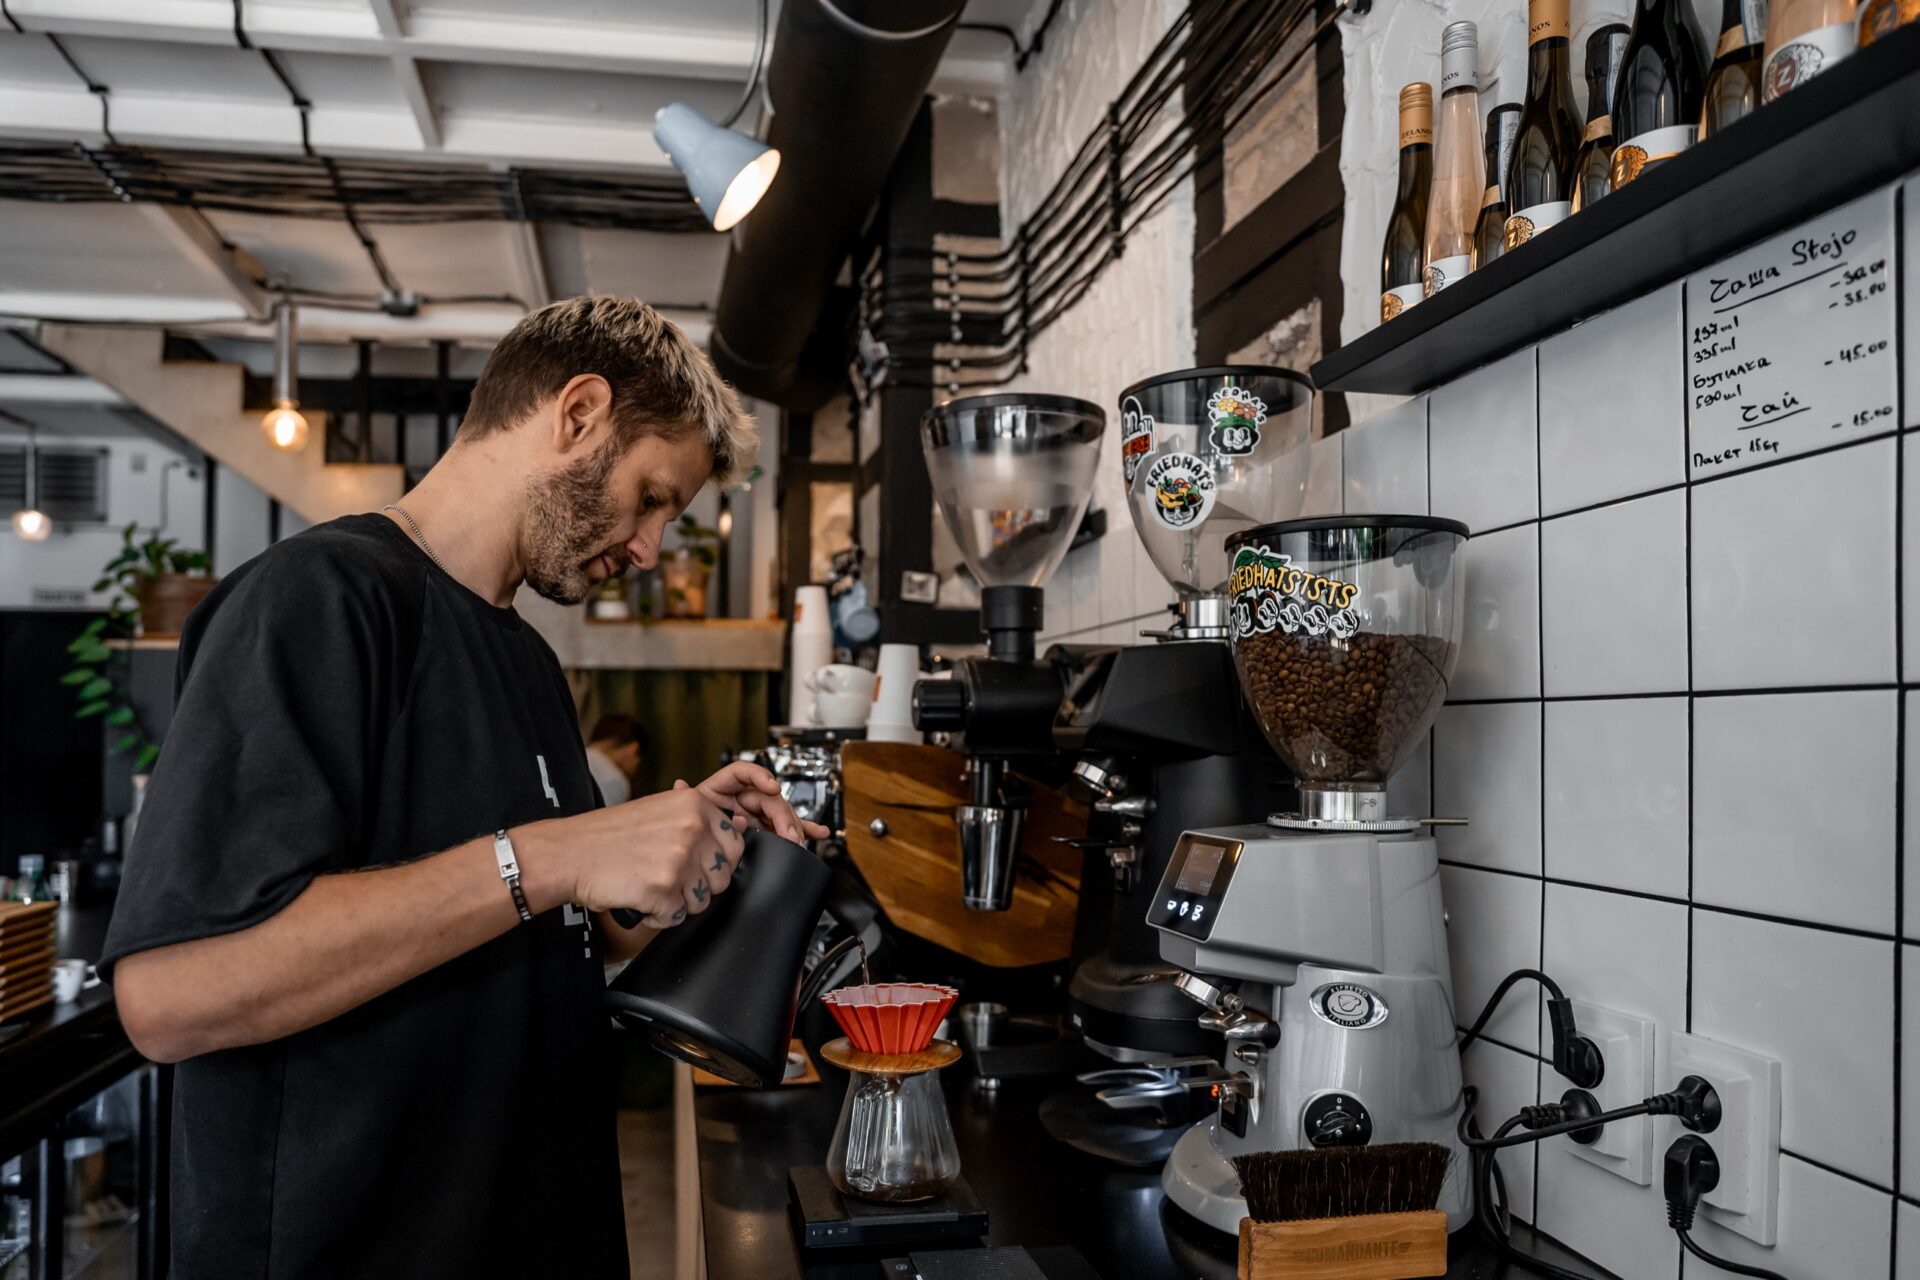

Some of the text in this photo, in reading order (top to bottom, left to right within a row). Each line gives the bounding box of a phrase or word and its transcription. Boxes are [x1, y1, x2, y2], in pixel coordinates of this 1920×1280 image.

[1791, 229, 1857, 266] Stojo
[1209, 388, 1266, 423] FRIEDHATS
[1147, 455, 1214, 490] FRIEDHATS
[1229, 563, 1358, 609] RIEDHATSTSTS
[1331, 985, 1368, 998] ESPRESSO
[1328, 1013, 1366, 1026] ITALIANO
